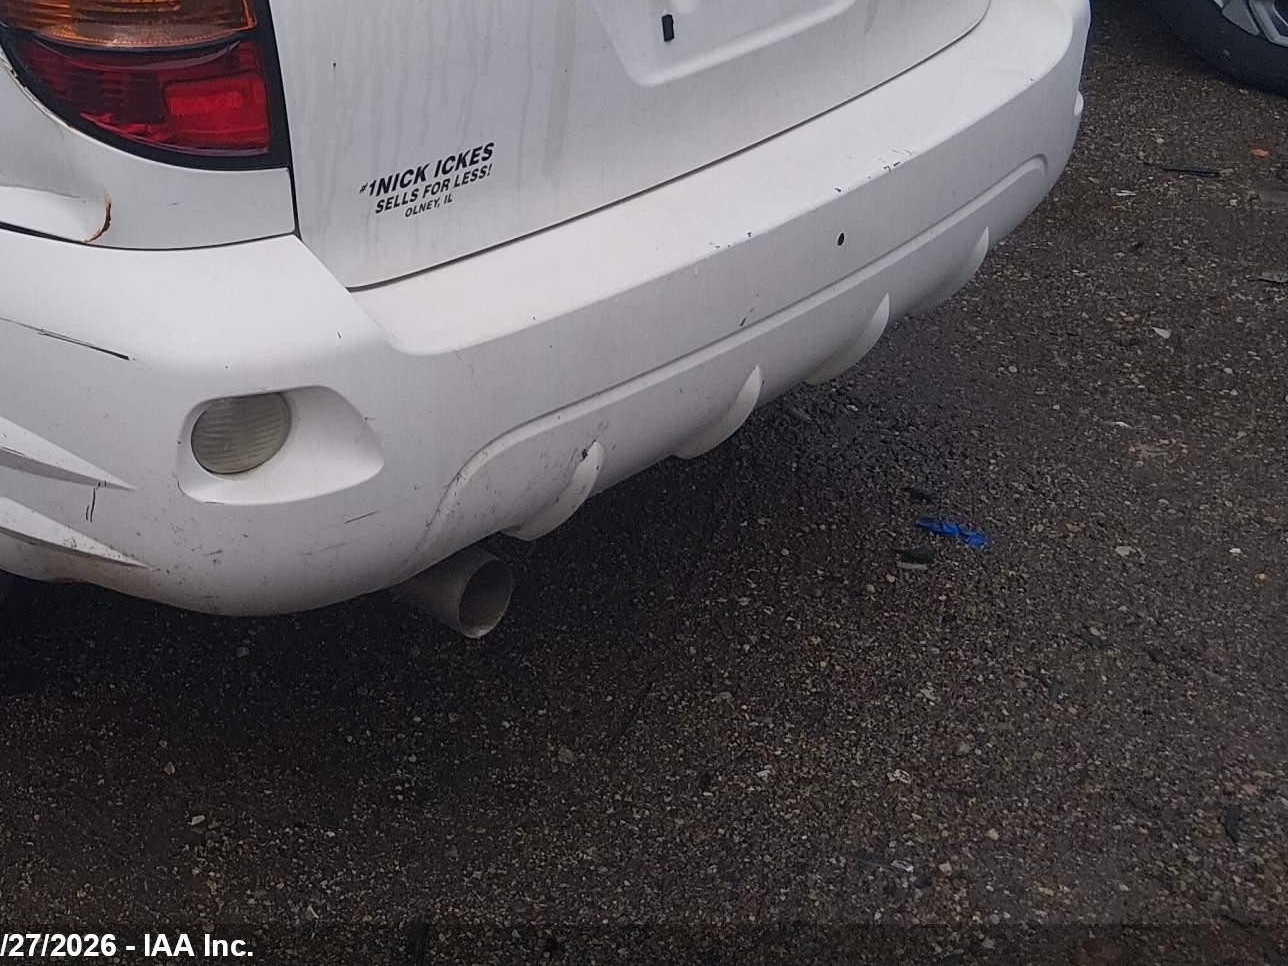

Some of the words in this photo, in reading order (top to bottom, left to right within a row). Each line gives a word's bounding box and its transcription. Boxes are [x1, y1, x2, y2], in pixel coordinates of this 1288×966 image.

[433, 142, 495, 179] ICKES
[375, 188, 419, 214] SELLS
[422, 178, 451, 199] FOR
[453, 163, 493, 188] LESS!
[404, 197, 441, 218] OLNEY,
[443, 193, 453, 204] IL
